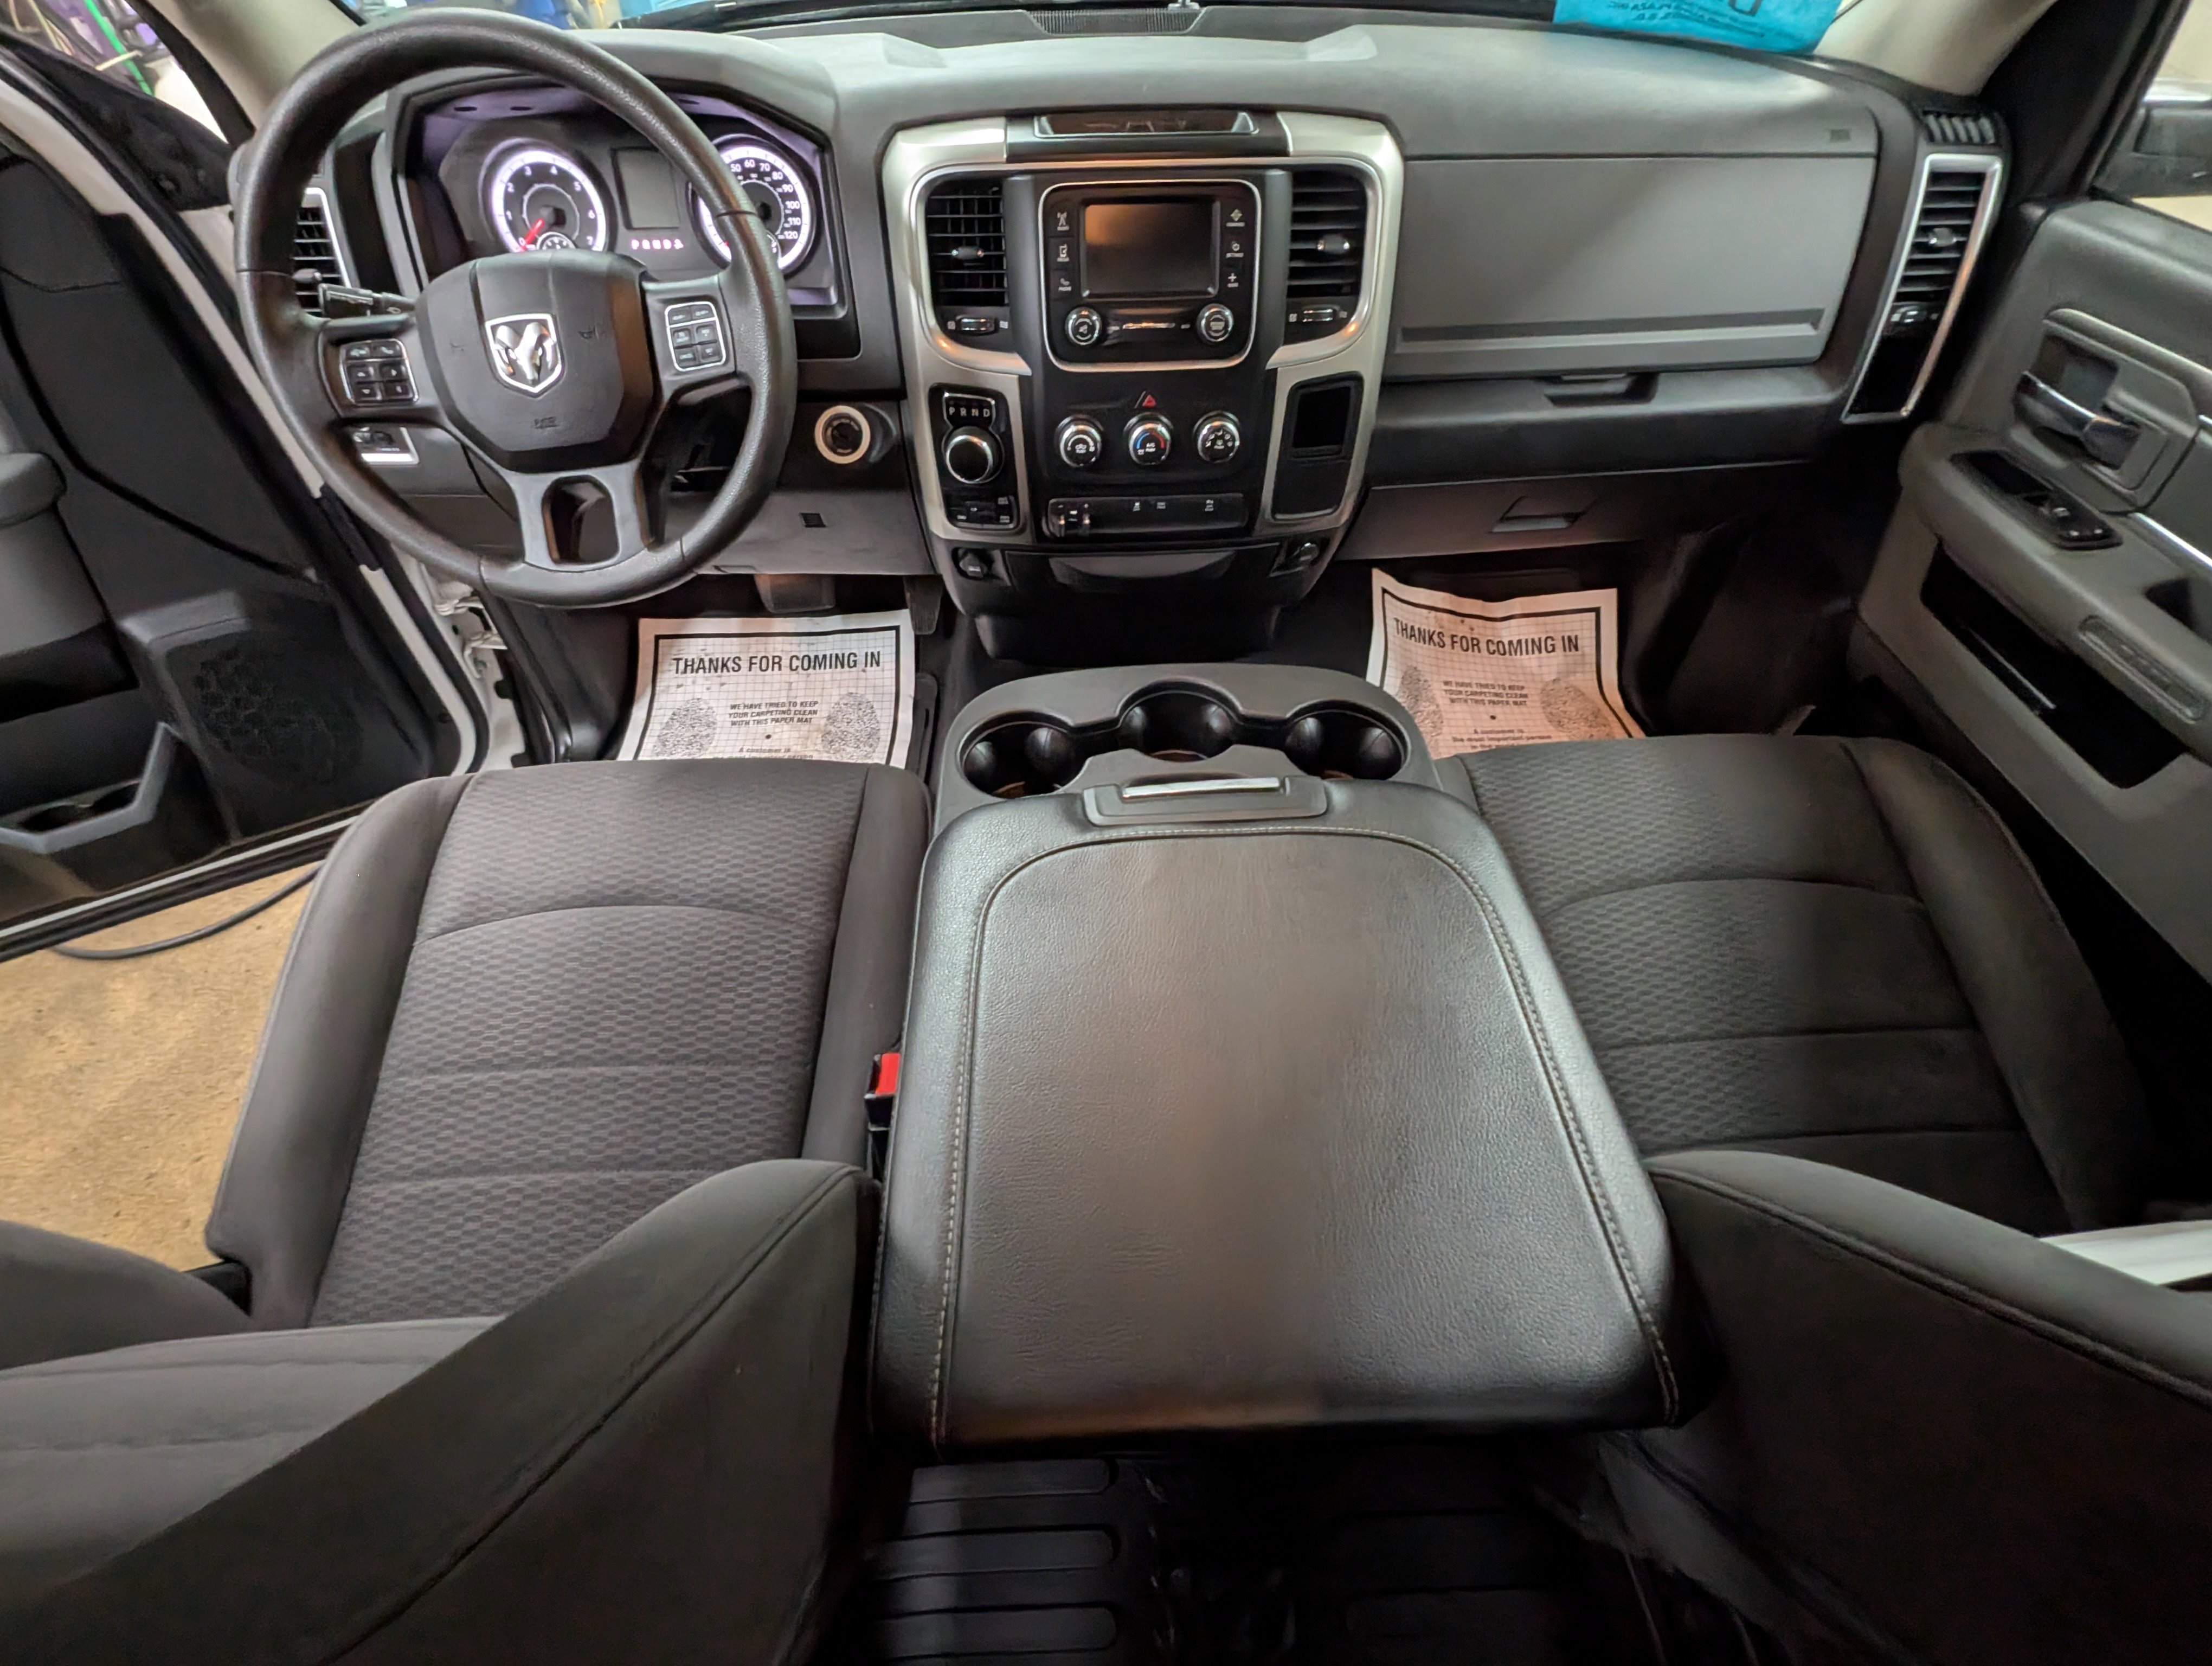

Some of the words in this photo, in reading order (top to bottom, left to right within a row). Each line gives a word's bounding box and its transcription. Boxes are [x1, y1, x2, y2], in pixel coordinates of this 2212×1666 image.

[730, 163, 742, 172] 50
[744, 159, 755, 168] 60
[760, 163, 770, 171] 70
[524, 166, 532, 176] 3
[550, 166, 558, 175] 4
[772, 171, 783, 180] 80
[507, 183, 514, 193] 2
[574, 182, 581, 191] 5
[782, 184, 793, 193] 90
[506, 210, 512, 220] 1
[588, 210, 595, 219] 6
[783, 231, 798, 239] 120
[586, 236, 593, 245] 7
[949, 407, 955, 415] P
[960, 407, 967, 416] R
[972, 408, 979, 416] N
[983, 408, 990, 417] D
[1394, 618, 1446, 648] THANKS
[1450, 634, 1481, 653] FOR
[1486, 636, 1555, 656] COMING
[1561, 635, 1579, 652] IN
[672, 655, 742, 674] THANKS
[749, 655, 782, 672] FOR
[789, 652, 858, 671] COMING
[864, 651, 880, 668] IN
[750, 709, 792, 717] CARPETING
